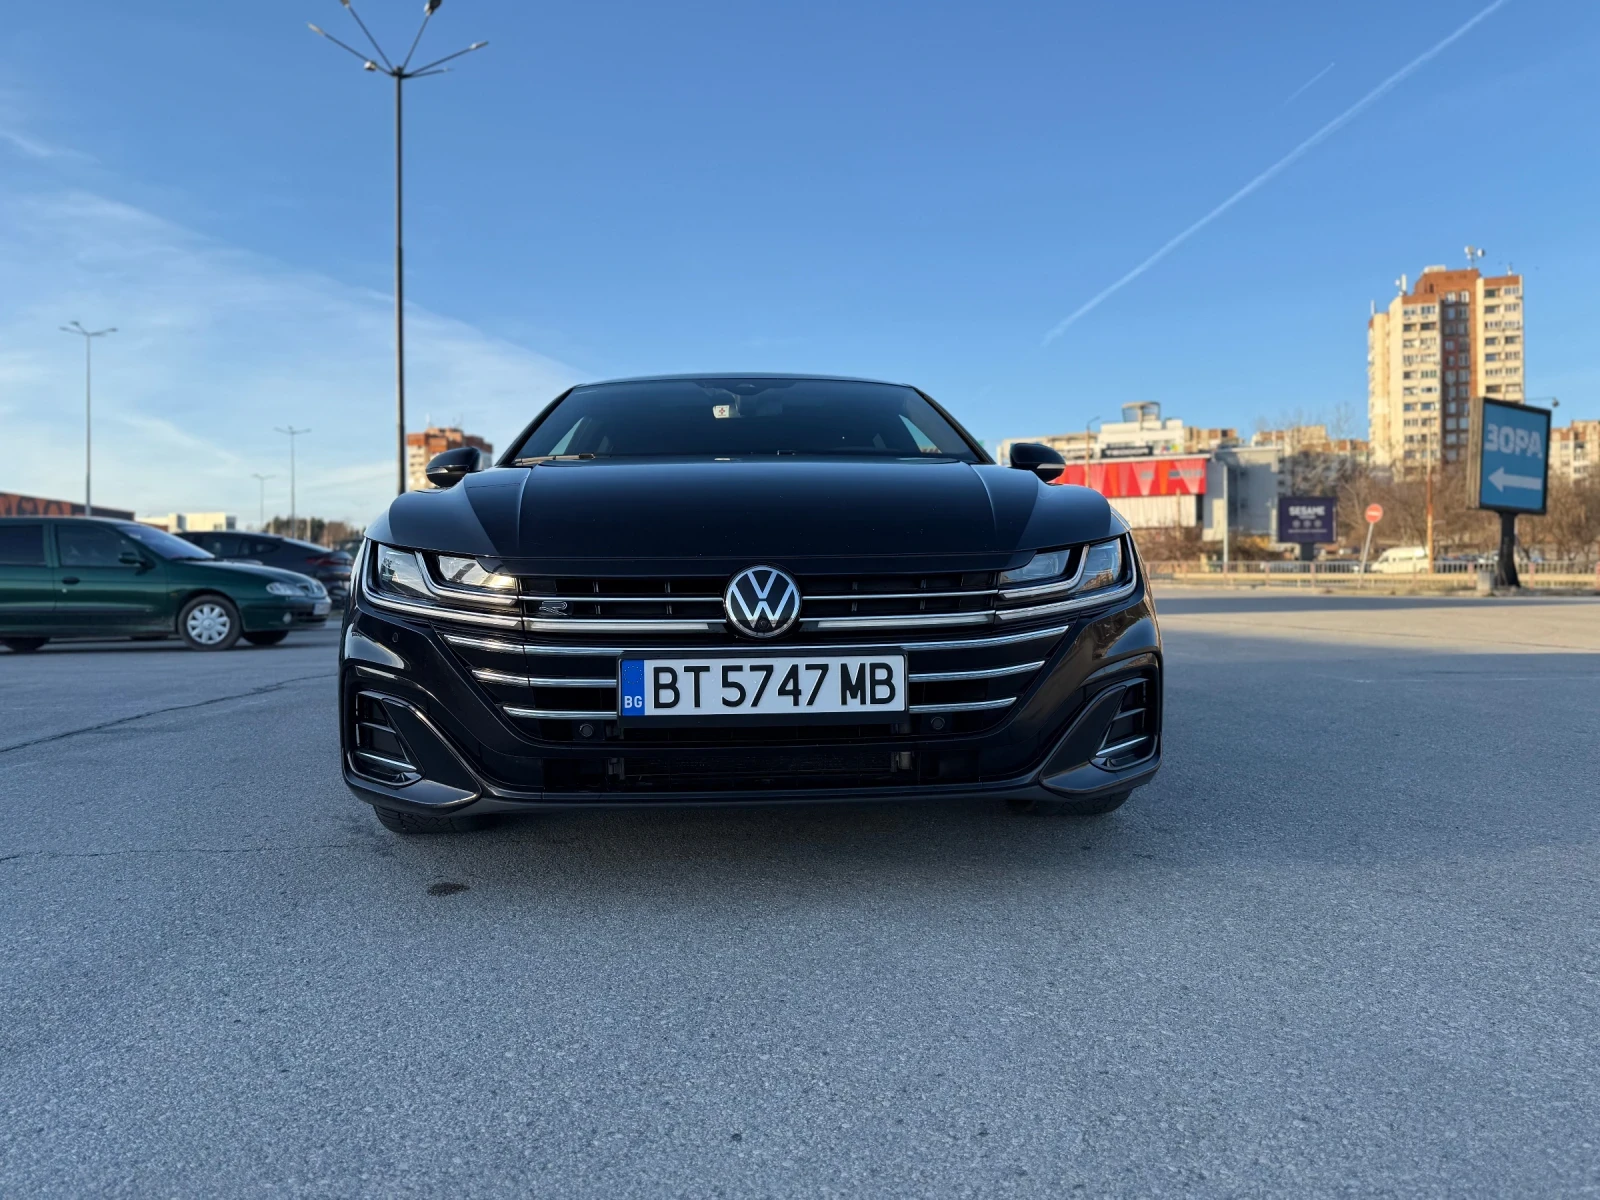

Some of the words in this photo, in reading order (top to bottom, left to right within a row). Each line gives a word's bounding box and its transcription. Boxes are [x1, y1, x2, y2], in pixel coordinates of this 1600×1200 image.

[1484, 423, 1543, 459] ЗОРА
[624, 695, 643, 709] BG
[653, 665, 711, 708] BT
[721, 663, 829, 708] 5747
[840, 662, 896, 706] MB
